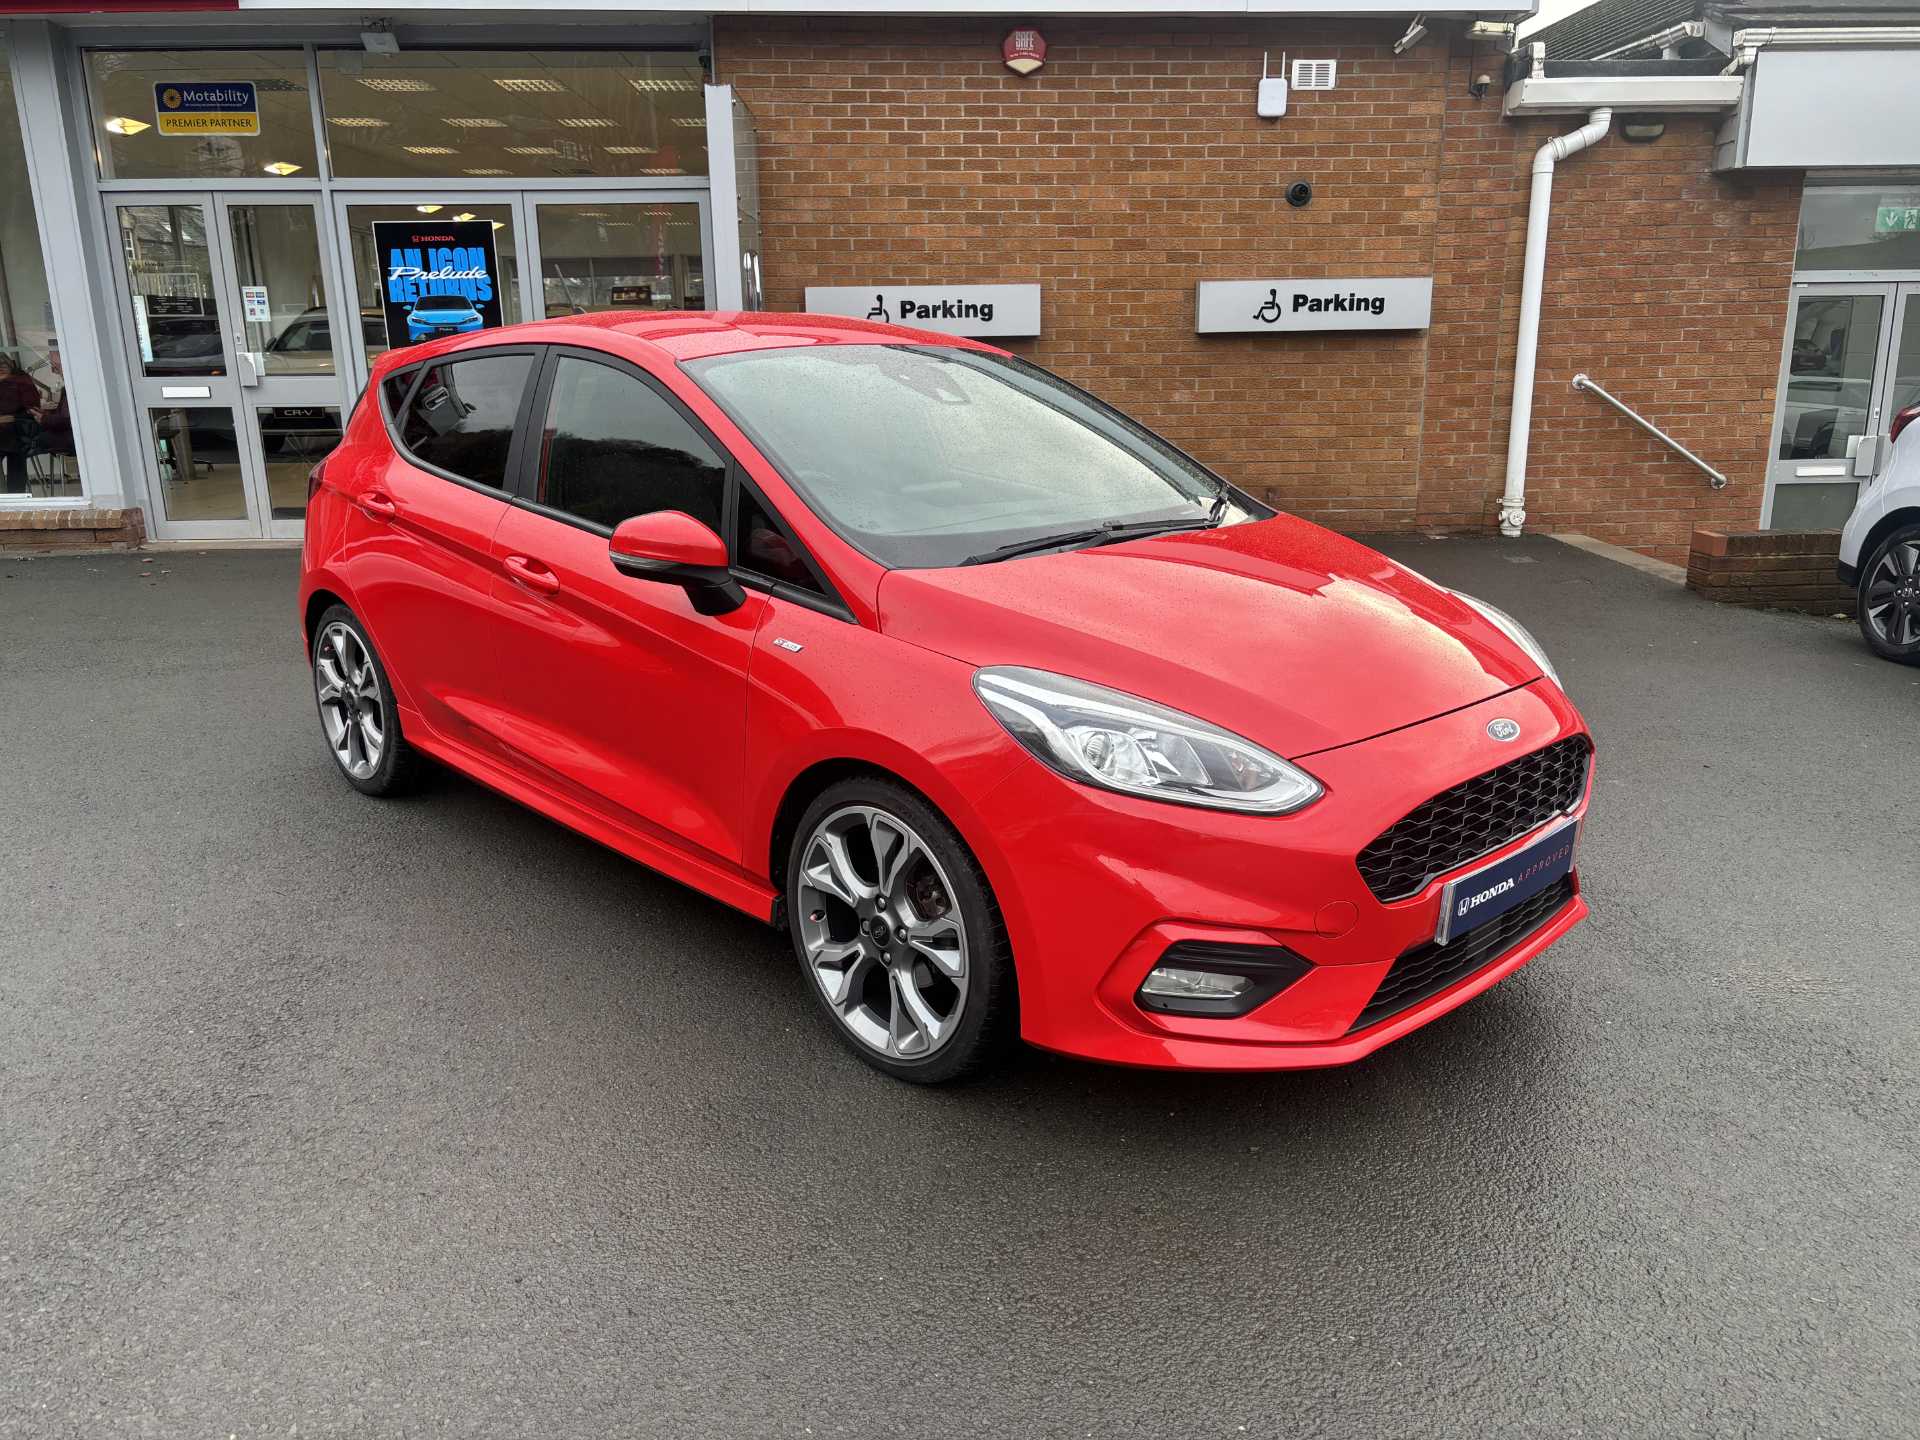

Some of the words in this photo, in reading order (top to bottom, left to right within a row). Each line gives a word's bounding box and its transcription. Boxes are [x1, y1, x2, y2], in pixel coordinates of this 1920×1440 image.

[183, 89, 249, 105] Motability
[210, 118, 253, 128] PARTNER
[390, 248, 423, 275] AN
[428, 247, 486, 273] ICON
[388, 265, 488, 280] Prelude
[388, 276, 493, 303] RETURNS
[900, 299, 994, 322] Parking
[1292, 293, 1385, 315] Parking
[1493, 724, 1514, 738] Ford
[1469, 877, 1515, 909] HONDA
[1517, 844, 1570, 882] APPROVED
